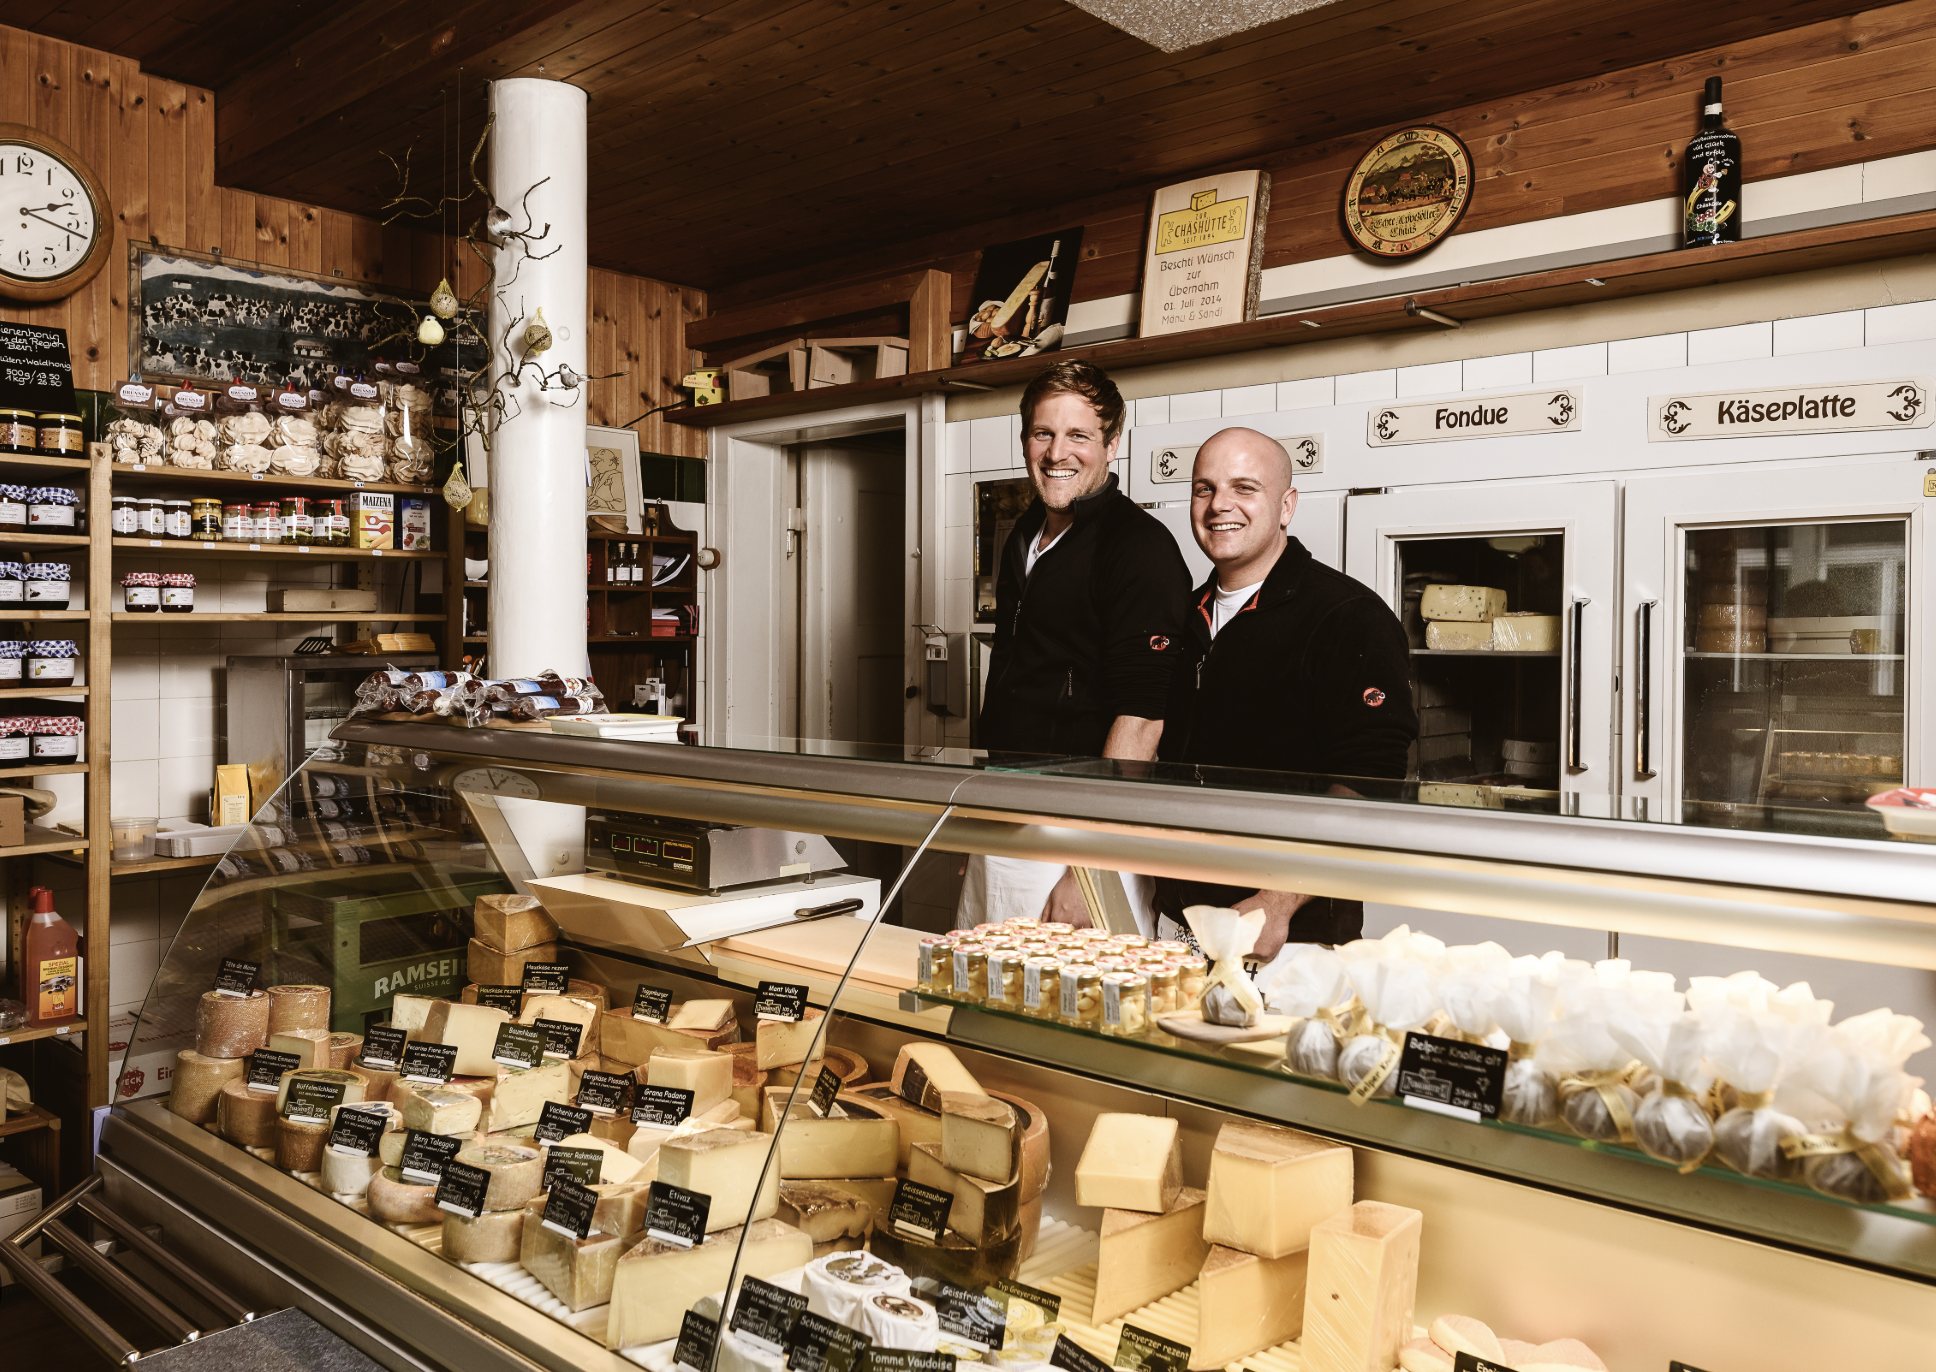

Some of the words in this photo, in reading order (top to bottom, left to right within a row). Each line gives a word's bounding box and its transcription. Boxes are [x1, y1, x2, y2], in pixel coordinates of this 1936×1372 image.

[1692, 151, 1704, 160] und
[1705, 149, 1725, 157] Erfolg
[17, 155, 34, 176] 12
[45, 168, 52, 185] 1
[1195, 211, 1207, 220] ZUR
[1174, 215, 1228, 237] CHÄSHÜTTE
[58, 234, 73, 252] 4
[1183, 236, 1197, 244] SEIT
[18, 248, 31, 267] 6
[43, 246, 56, 266] 5
[1160, 257, 1194, 271] Beschti
[1197, 250, 1234, 265] Wünsch
[1187, 270, 1202, 280] zur
[1169, 281, 1219, 296] Übernahm
[1180, 299, 1194, 310] Juli
[1200, 295, 1221, 306] 2014
[0, 323, 60, 343] ienenhonig
[5, 341, 33, 352] Bern
[11, 336, 29, 345] der
[29, 338, 66, 349] Region
[1435, 404, 1509, 430] Fondue
[1717, 394, 1856, 425] Käseplatte
[362, 495, 392, 508] MAIZENA
[414, 979, 438, 991] SUISSE
[440, 977, 451, 986] AG
[769, 985, 783, 993] Mont
[536, 1021, 555, 1030] Pecorino
[562, 1025, 580, 1033] Tartufo
[406, 1043, 428, 1052] Pecorino
[1409, 1036, 1446, 1054] Belper
[1448, 1046, 1483, 1063] Knolle
[583, 1072, 608, 1084] Bergkäse
[1356, 1070, 1381, 1098] Belper
[296, 1082, 339, 1094] Büffelmilchkäse
[644, 1088, 663, 1099] Grana
[664, 1090, 687, 1101] Padano
[341, 1111, 357, 1121] Geiss
[549, 1106, 574, 1118] Vacherin
[573, 1112, 588, 1121] AOP
[413, 1134, 429, 1145] Berg
[430, 1137, 455, 1150] Taleggio
[548, 1149, 574, 1159] Luzerner
[574, 1151, 603, 1161] Rahmkäse
[669, 1189, 691, 1203] Etivaz
[902, 1182, 948, 1204] Geissenzauber
[742, 1279, 786, 1304] Schönrieder
[787, 1296, 807, 1312] 100%
[998, 1281, 1009, 1293] Typ
[1009, 1285, 1041, 1302] Greyerzer
[800, 1315, 851, 1344] Schönriederli
[1122, 1327, 1162, 1349] Greyerzer
[1162, 1344, 1190, 1360] rezent
[869, 1351, 904, 1365] Tomme
[907, 1355, 953, 1371] Vaudoise
